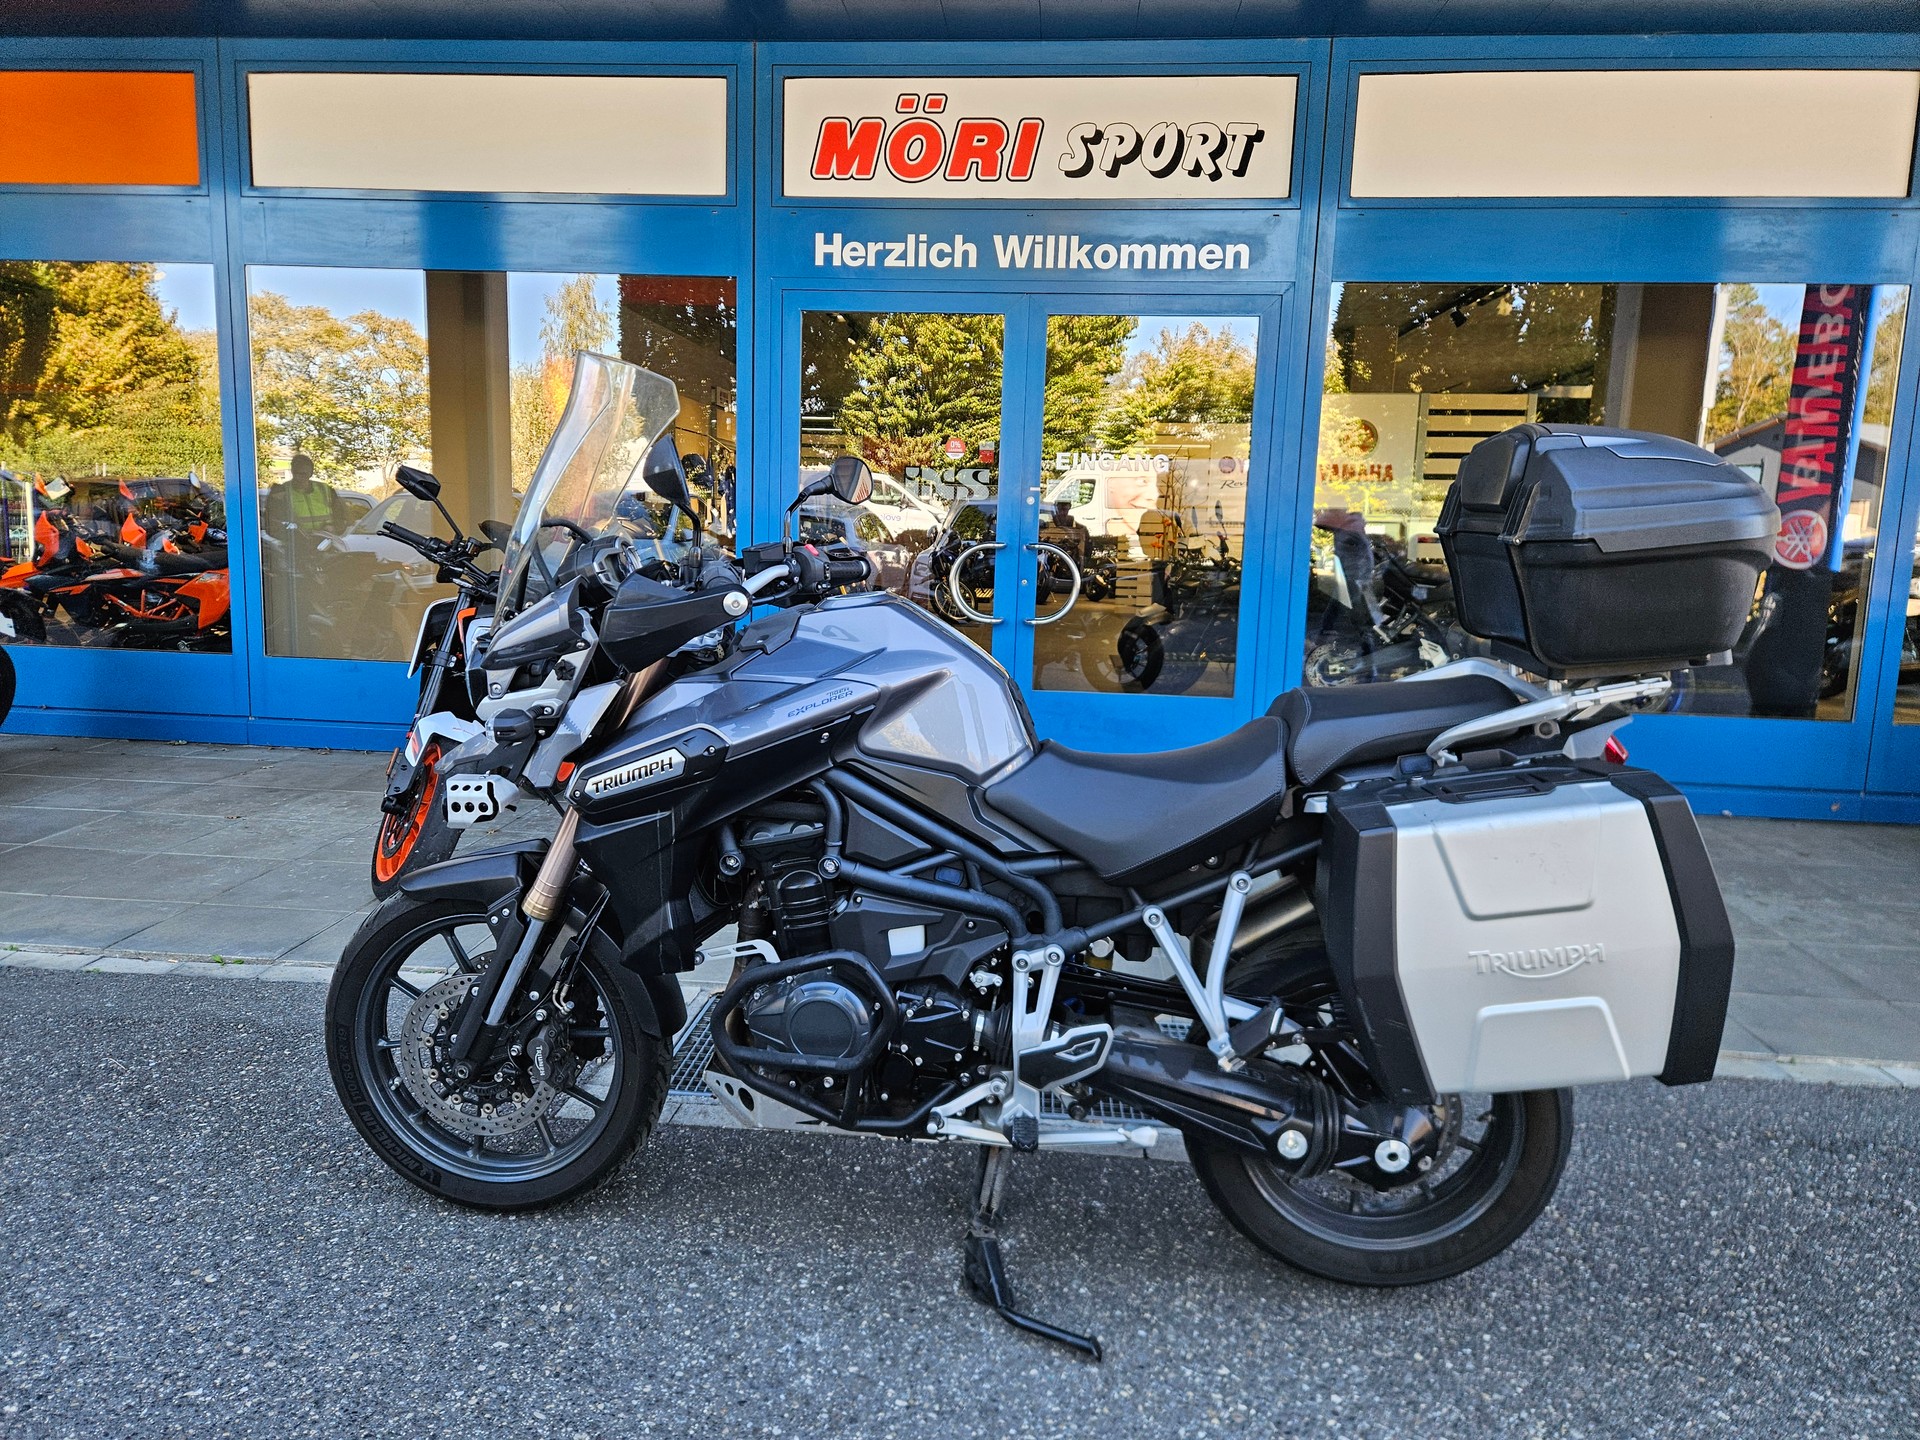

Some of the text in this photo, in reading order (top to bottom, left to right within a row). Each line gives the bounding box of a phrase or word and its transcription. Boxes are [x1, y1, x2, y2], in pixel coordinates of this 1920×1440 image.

[810, 93, 1265, 183] MÖRI SPORT
[814, 232, 1250, 271] Herzlich Willkommen
[1055, 452, 1170, 472] EINGANG
[787, 690, 854, 718] EXPLORER
[592, 756, 674, 795] TRIUMPH
[1468, 943, 1607, 975] TRIUMPH
[360, 1110, 419, 1170] MICHELIN
